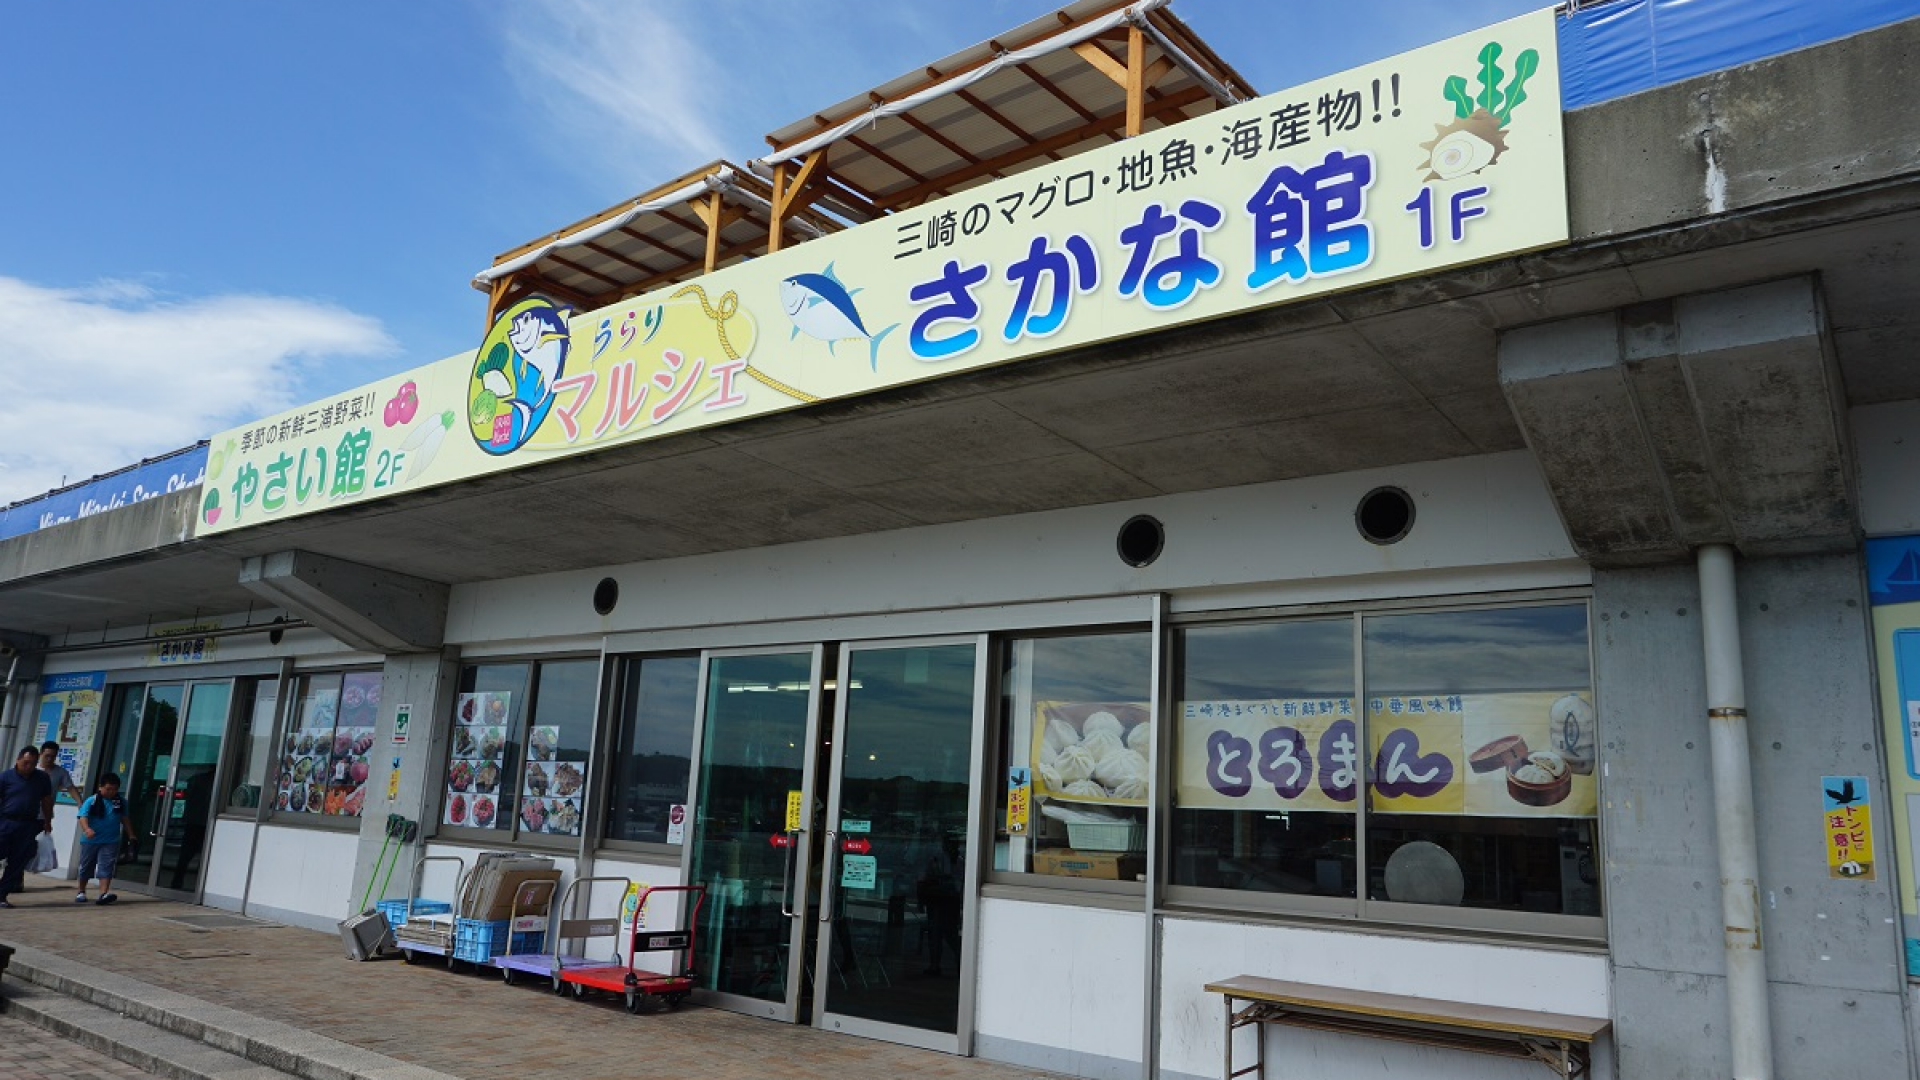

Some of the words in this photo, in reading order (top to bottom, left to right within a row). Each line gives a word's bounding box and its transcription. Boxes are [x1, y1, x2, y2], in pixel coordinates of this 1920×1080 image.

[893, 73, 1402, 260] 三崎のマグロ・地魚・海産物!!
[908, 149, 1373, 360] さかな館
[1405, 185, 1488, 249] 1F
[592, 305, 663, 361] うらり
[551, 349, 746, 441] マルシェ
[231, 426, 372, 521] やさい館
[374, 449, 405, 489] 2F
[1214, 730, 1442, 791] とろまん
[1828, 815, 1849, 860] 注意!!
[1845, 805, 1865, 851] トンビに
